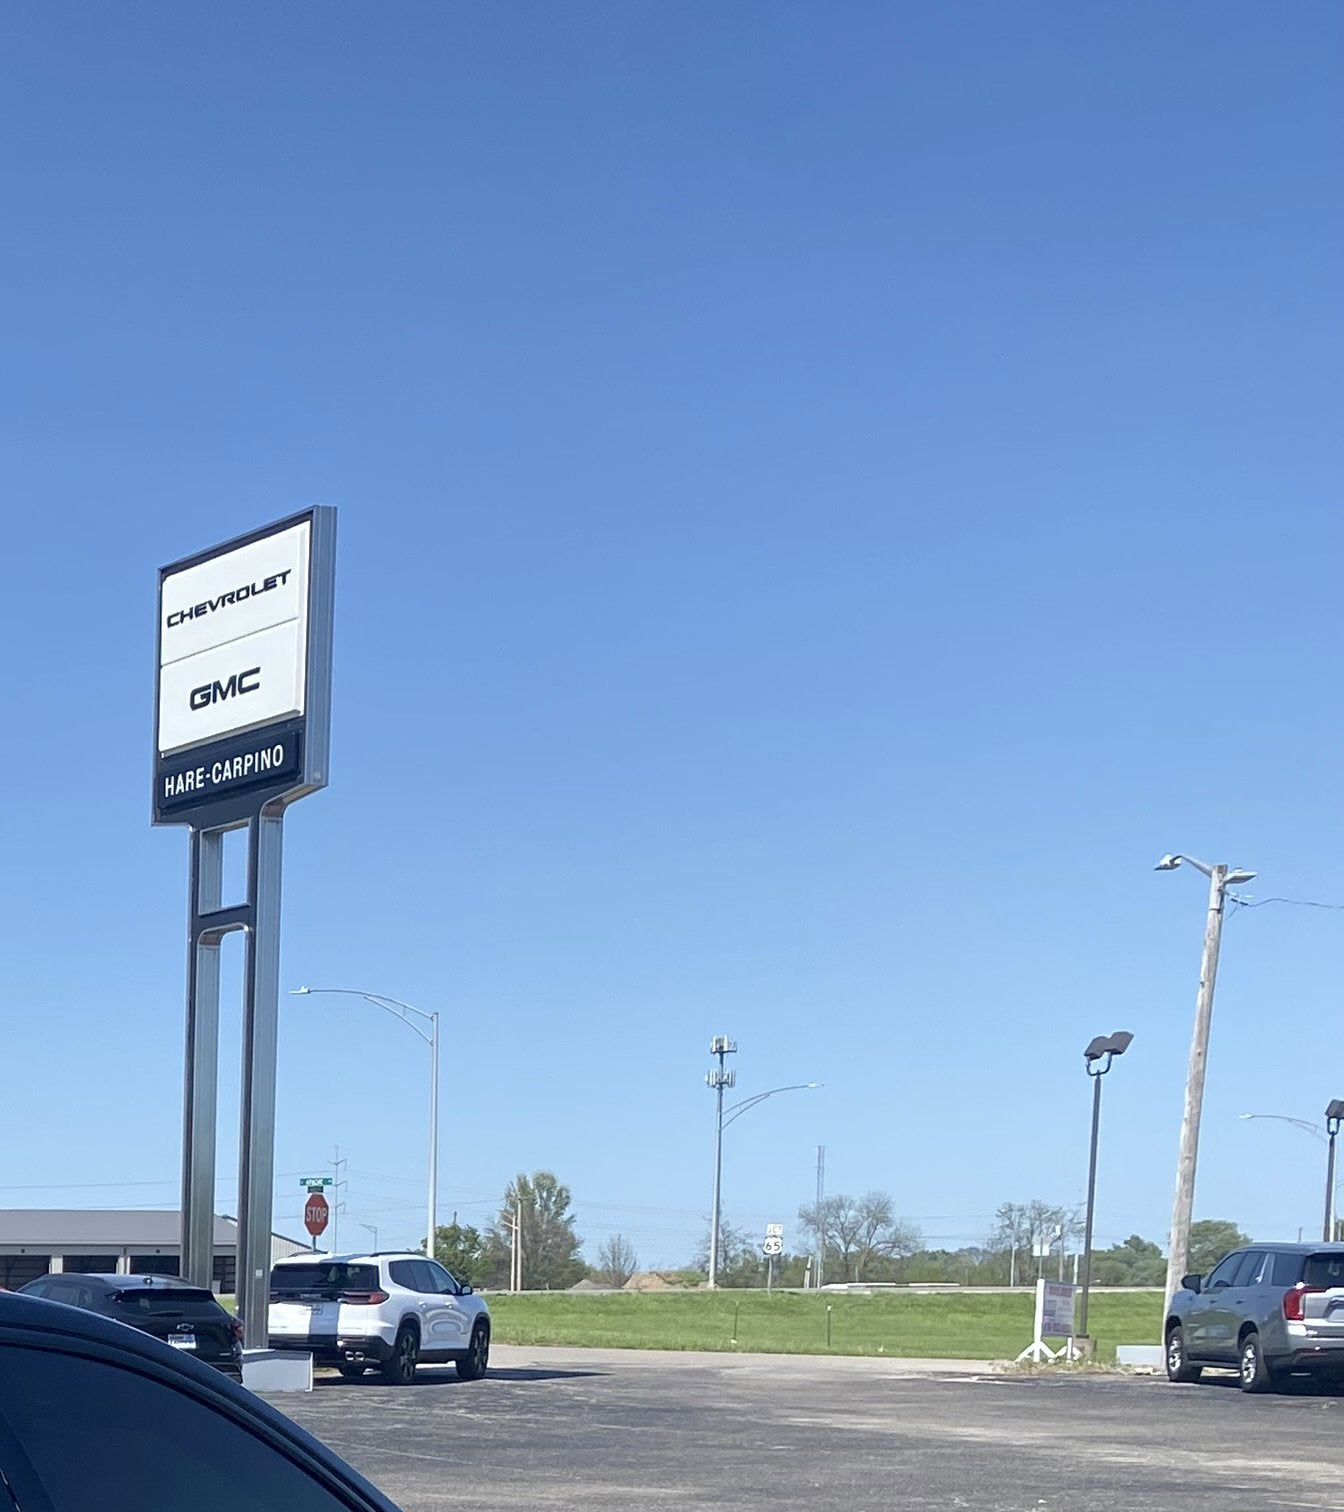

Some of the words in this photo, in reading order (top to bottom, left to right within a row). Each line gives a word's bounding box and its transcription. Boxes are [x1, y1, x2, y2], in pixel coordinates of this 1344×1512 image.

[166, 568, 292, 629] CHEVROLET
[189, 666, 261, 712] GMC
[164, 743, 284, 798] HARE-CARPINO
[306, 1206, 328, 1222] STOP
[765, 1241, 781, 1251] 65
